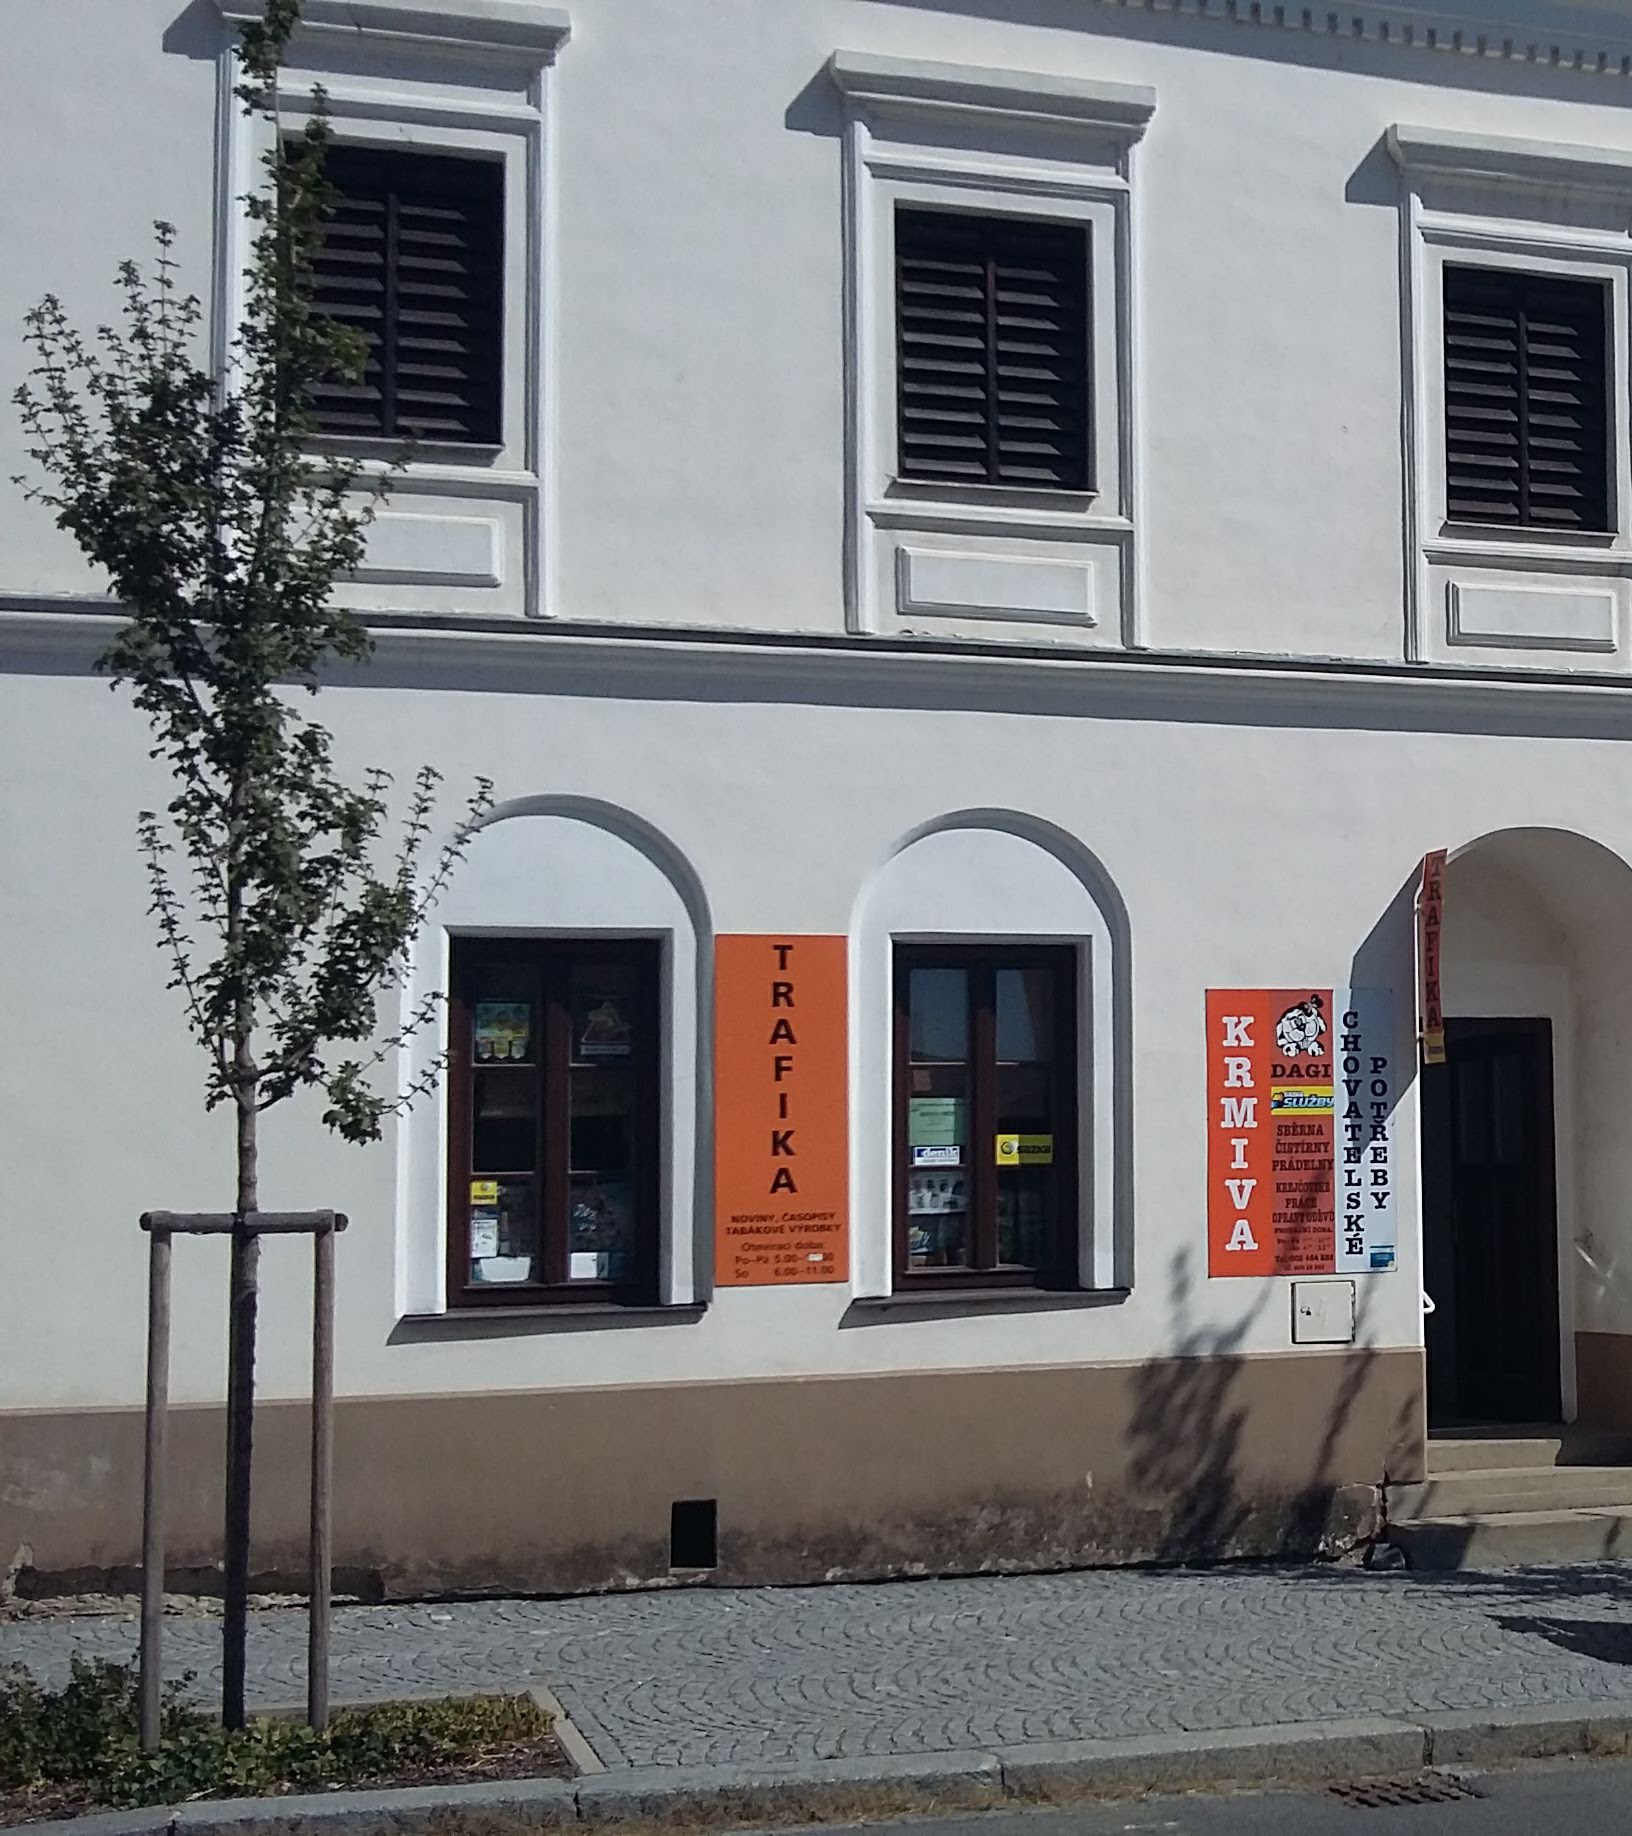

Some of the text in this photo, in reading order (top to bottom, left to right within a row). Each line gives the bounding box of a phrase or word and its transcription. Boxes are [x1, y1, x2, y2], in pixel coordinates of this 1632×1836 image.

[1426, 857, 1442, 1028] TRAFIKA
[769, 943, 798, 1195] TRAFIKA
[1220, 1015, 1258, 1251] KRMIVA
[1270, 1063, 1331, 1079] DAGI
[1276, 1122, 1324, 1136] SBĚRNA
[1340, 1011, 1365, 1255] CHOVATELSKÉ
[1369, 1056, 1391, 1210] POTŘEBY
[782, 1211, 836, 1222] ČASOPISY
